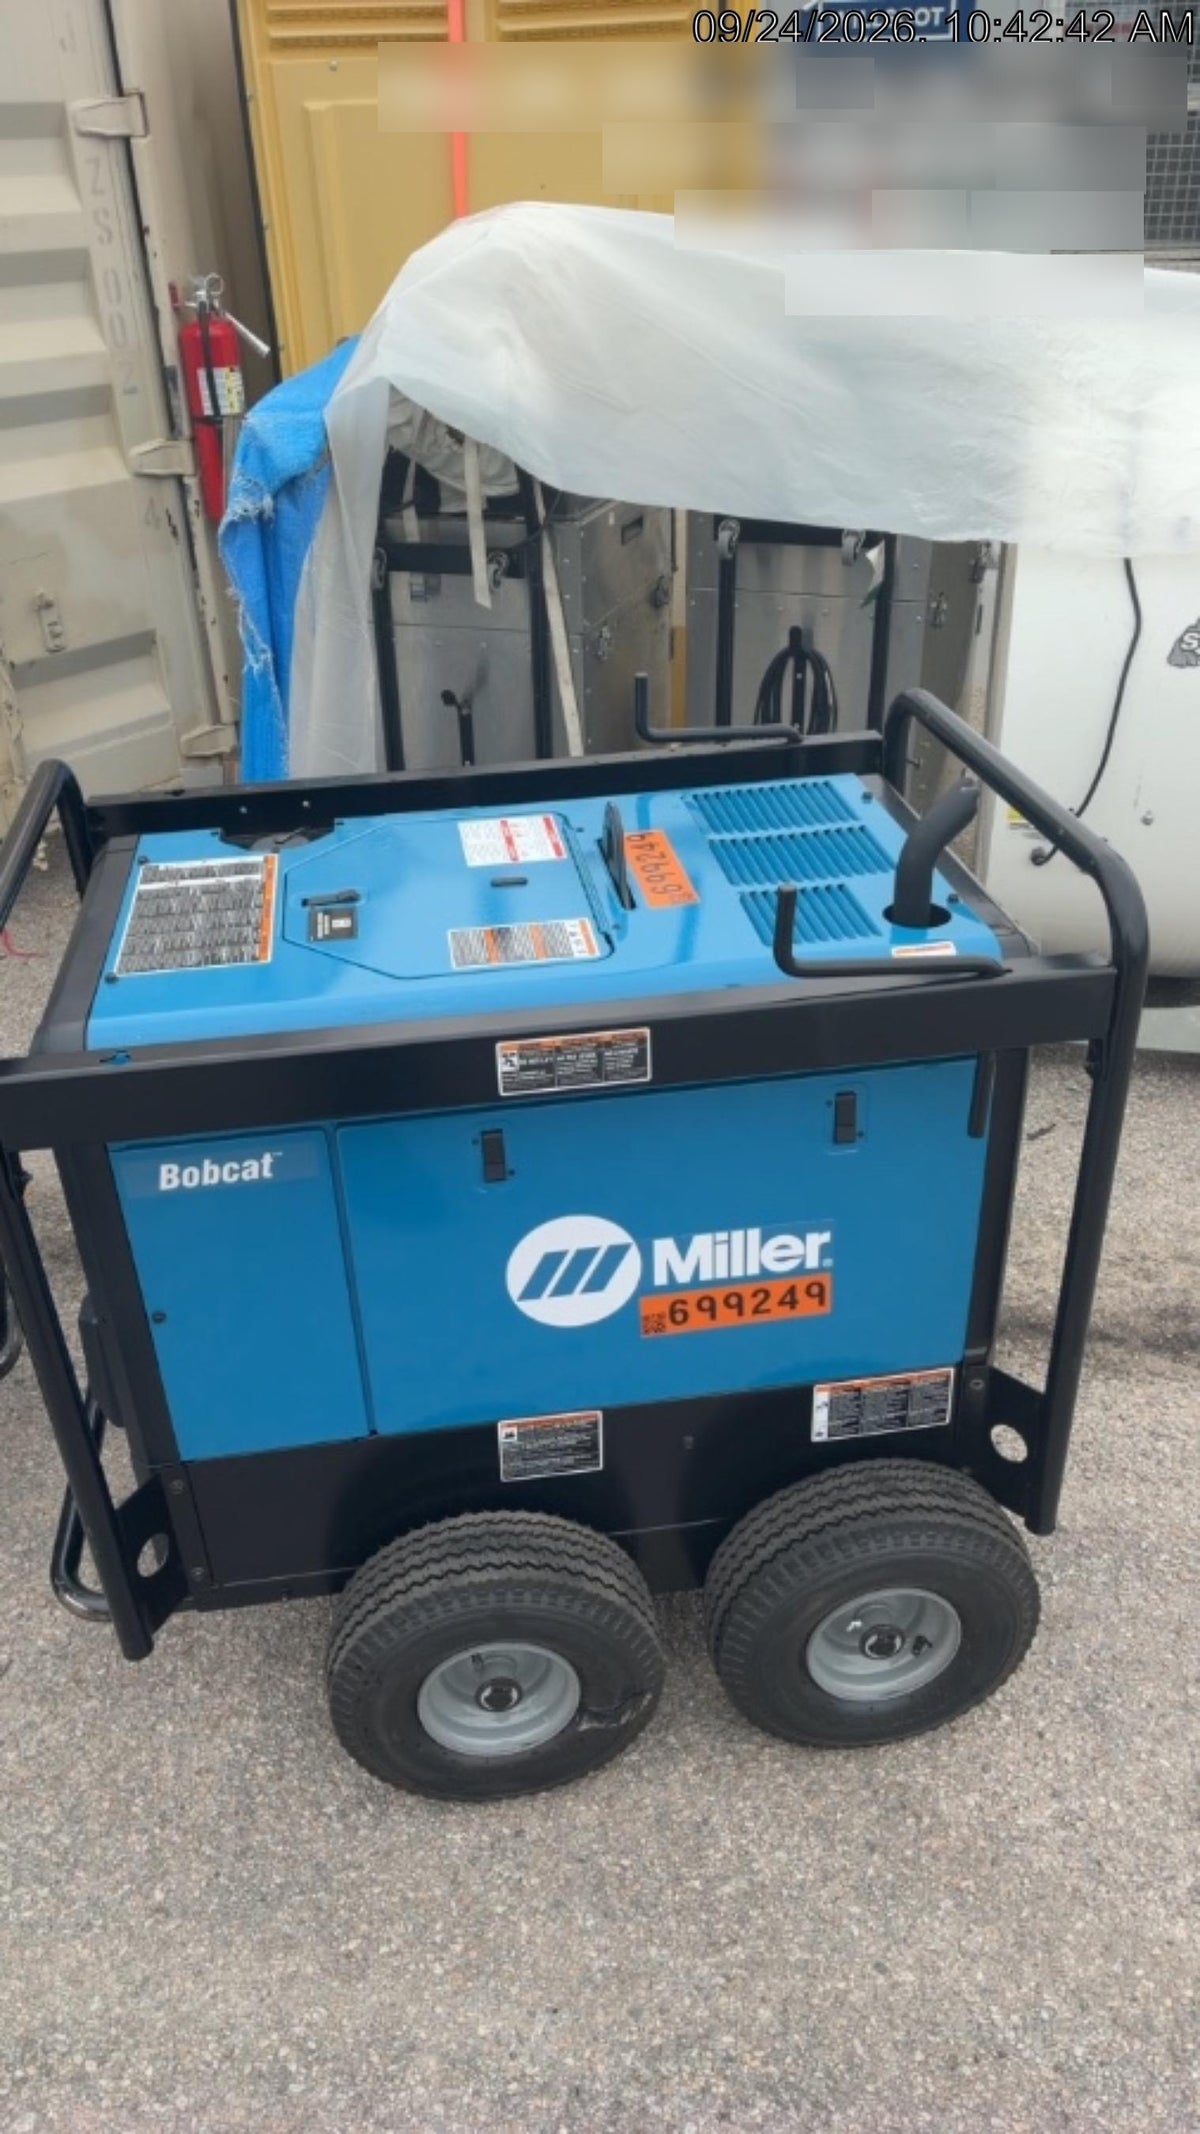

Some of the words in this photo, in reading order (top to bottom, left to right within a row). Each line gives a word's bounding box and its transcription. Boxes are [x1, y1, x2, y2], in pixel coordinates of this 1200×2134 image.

[158, 1151, 275, 1191] Bobcat
[652, 1227, 833, 1287] Miller
[668, 1281, 827, 1327] 699249
